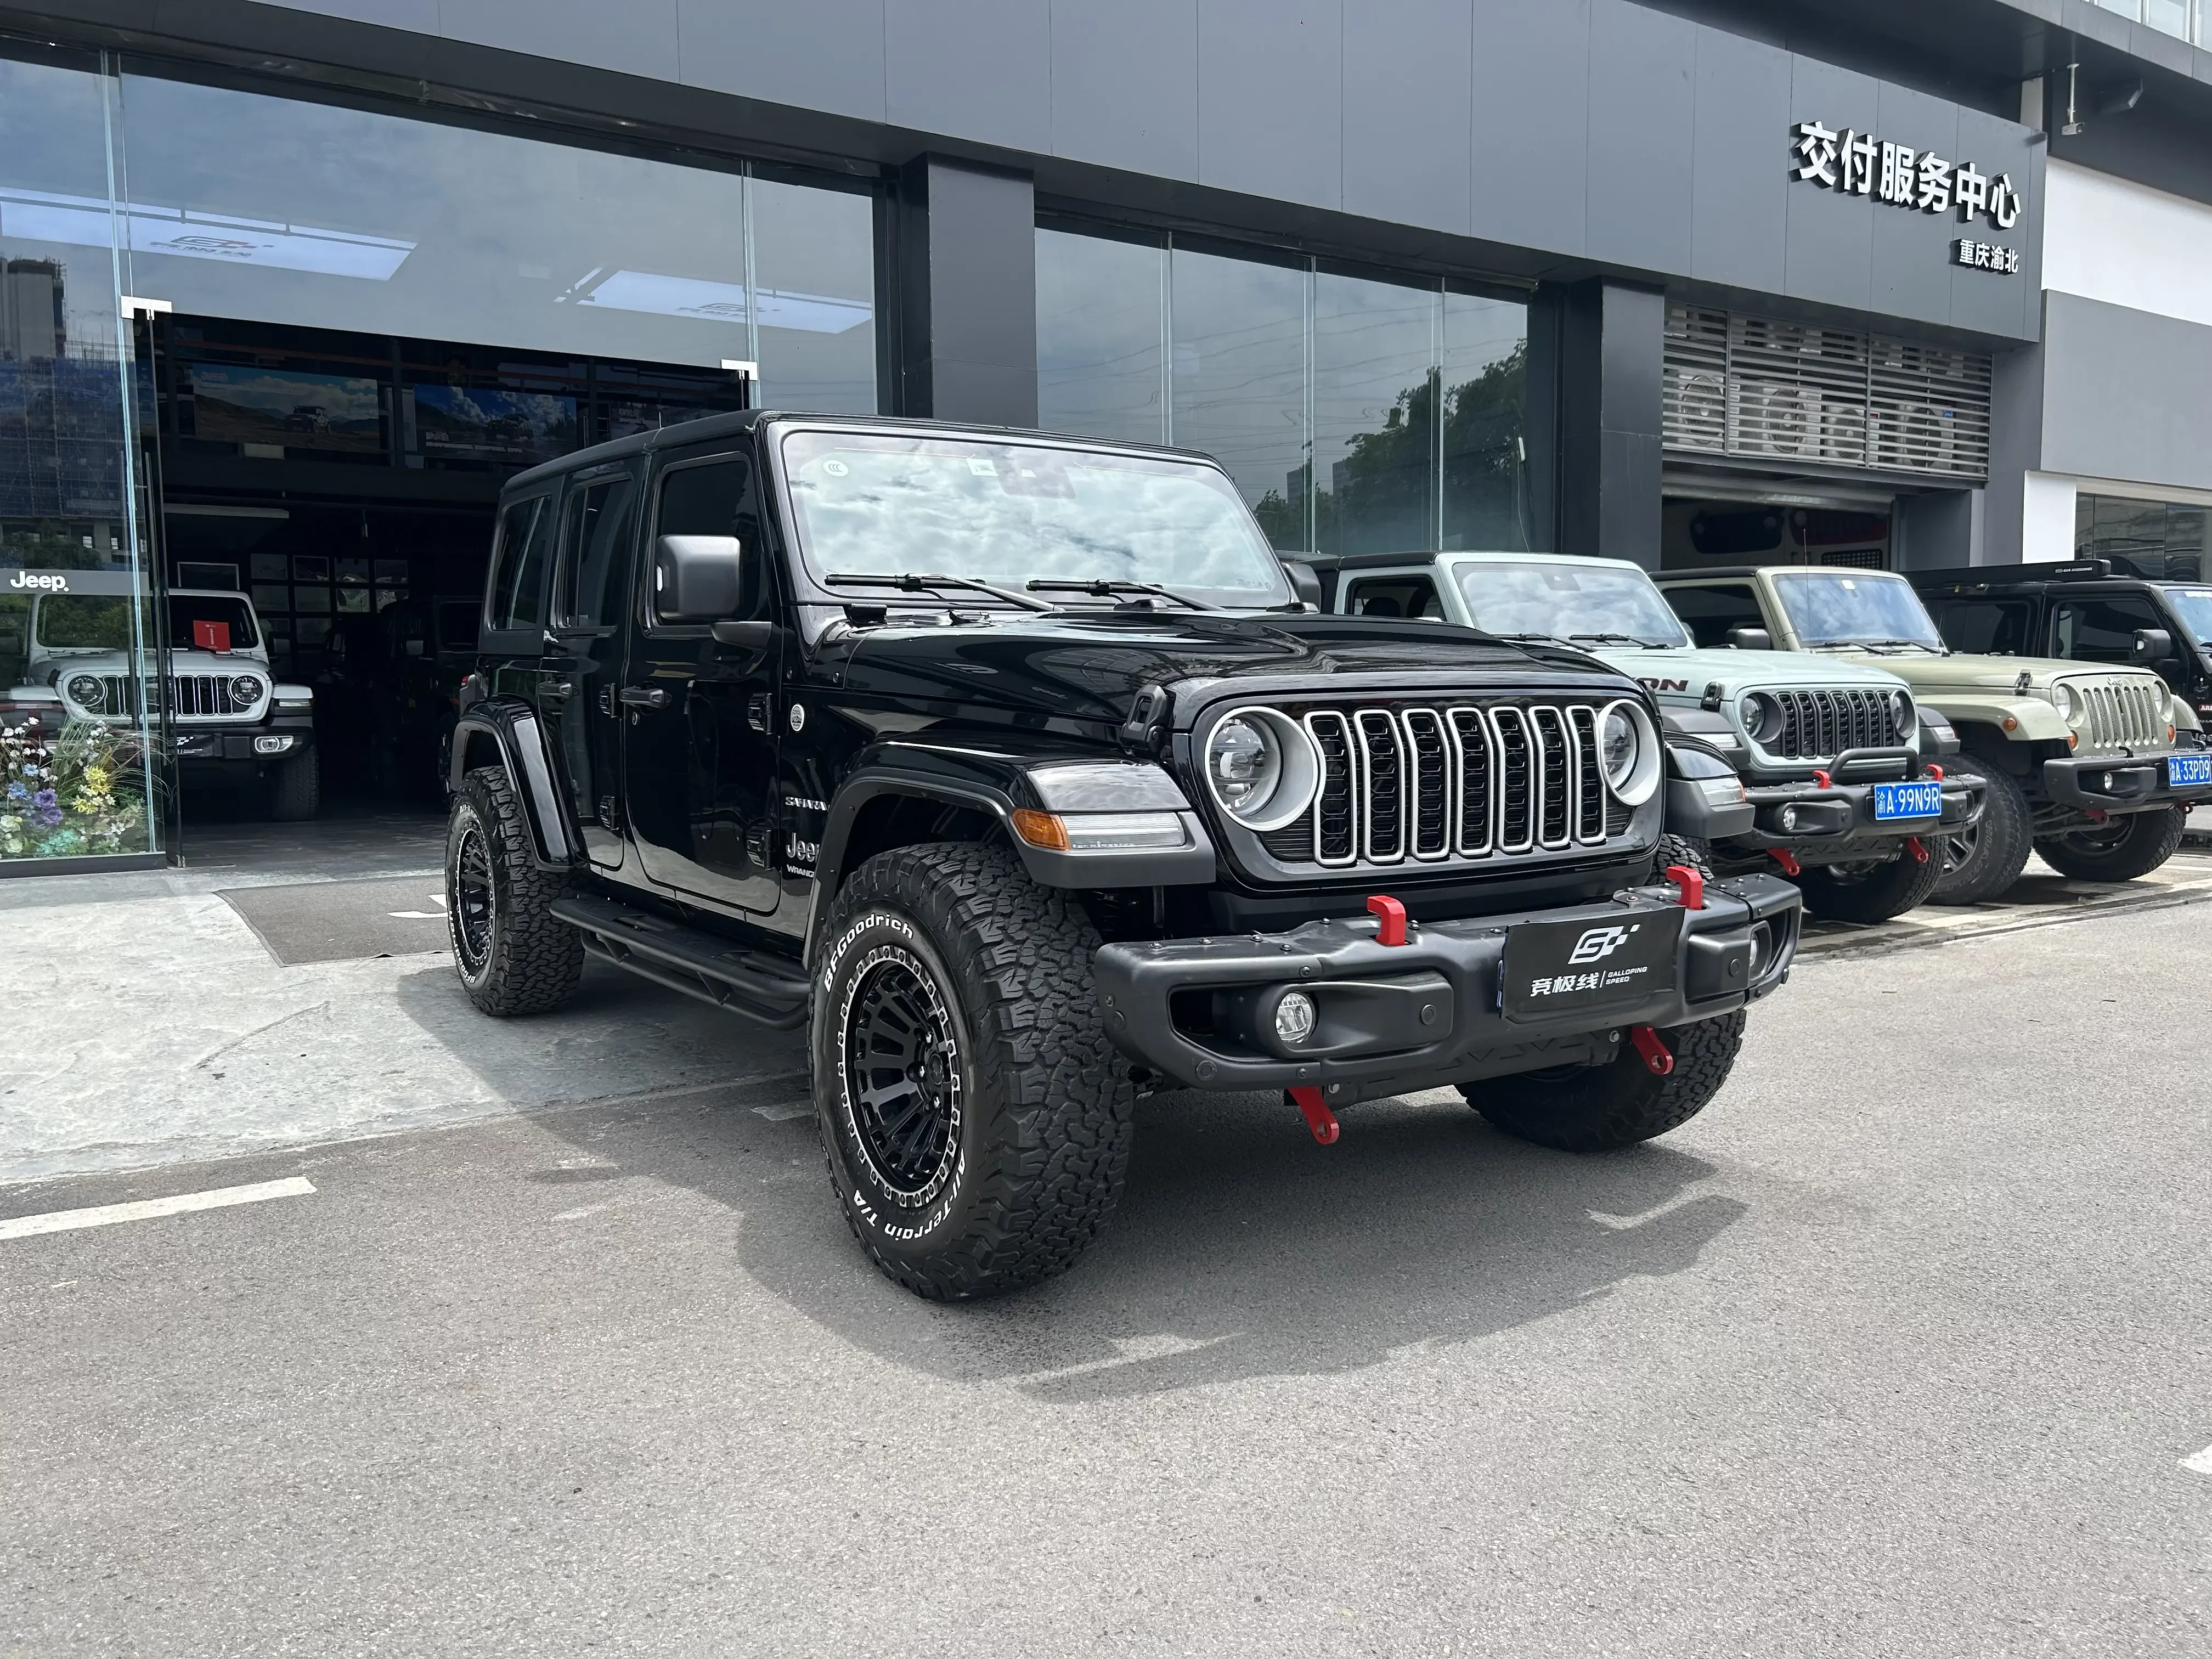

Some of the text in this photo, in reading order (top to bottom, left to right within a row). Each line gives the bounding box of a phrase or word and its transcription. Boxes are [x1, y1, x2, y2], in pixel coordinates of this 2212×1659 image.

[1799, 121, 2021, 228] 交付服务中心
[1960, 239, 2019, 273] 重庆渝北
[785, 797, 827, 811] SAHARA
[824, 913, 913, 992] BFGoodrich
[1530, 972, 1599, 997] 竞极线
[1605, 976, 1629, 985] SPEED
[1607, 967, 1647, 978] GALLOPING
[854, 1148, 966, 1241] All-Terrain T/A
